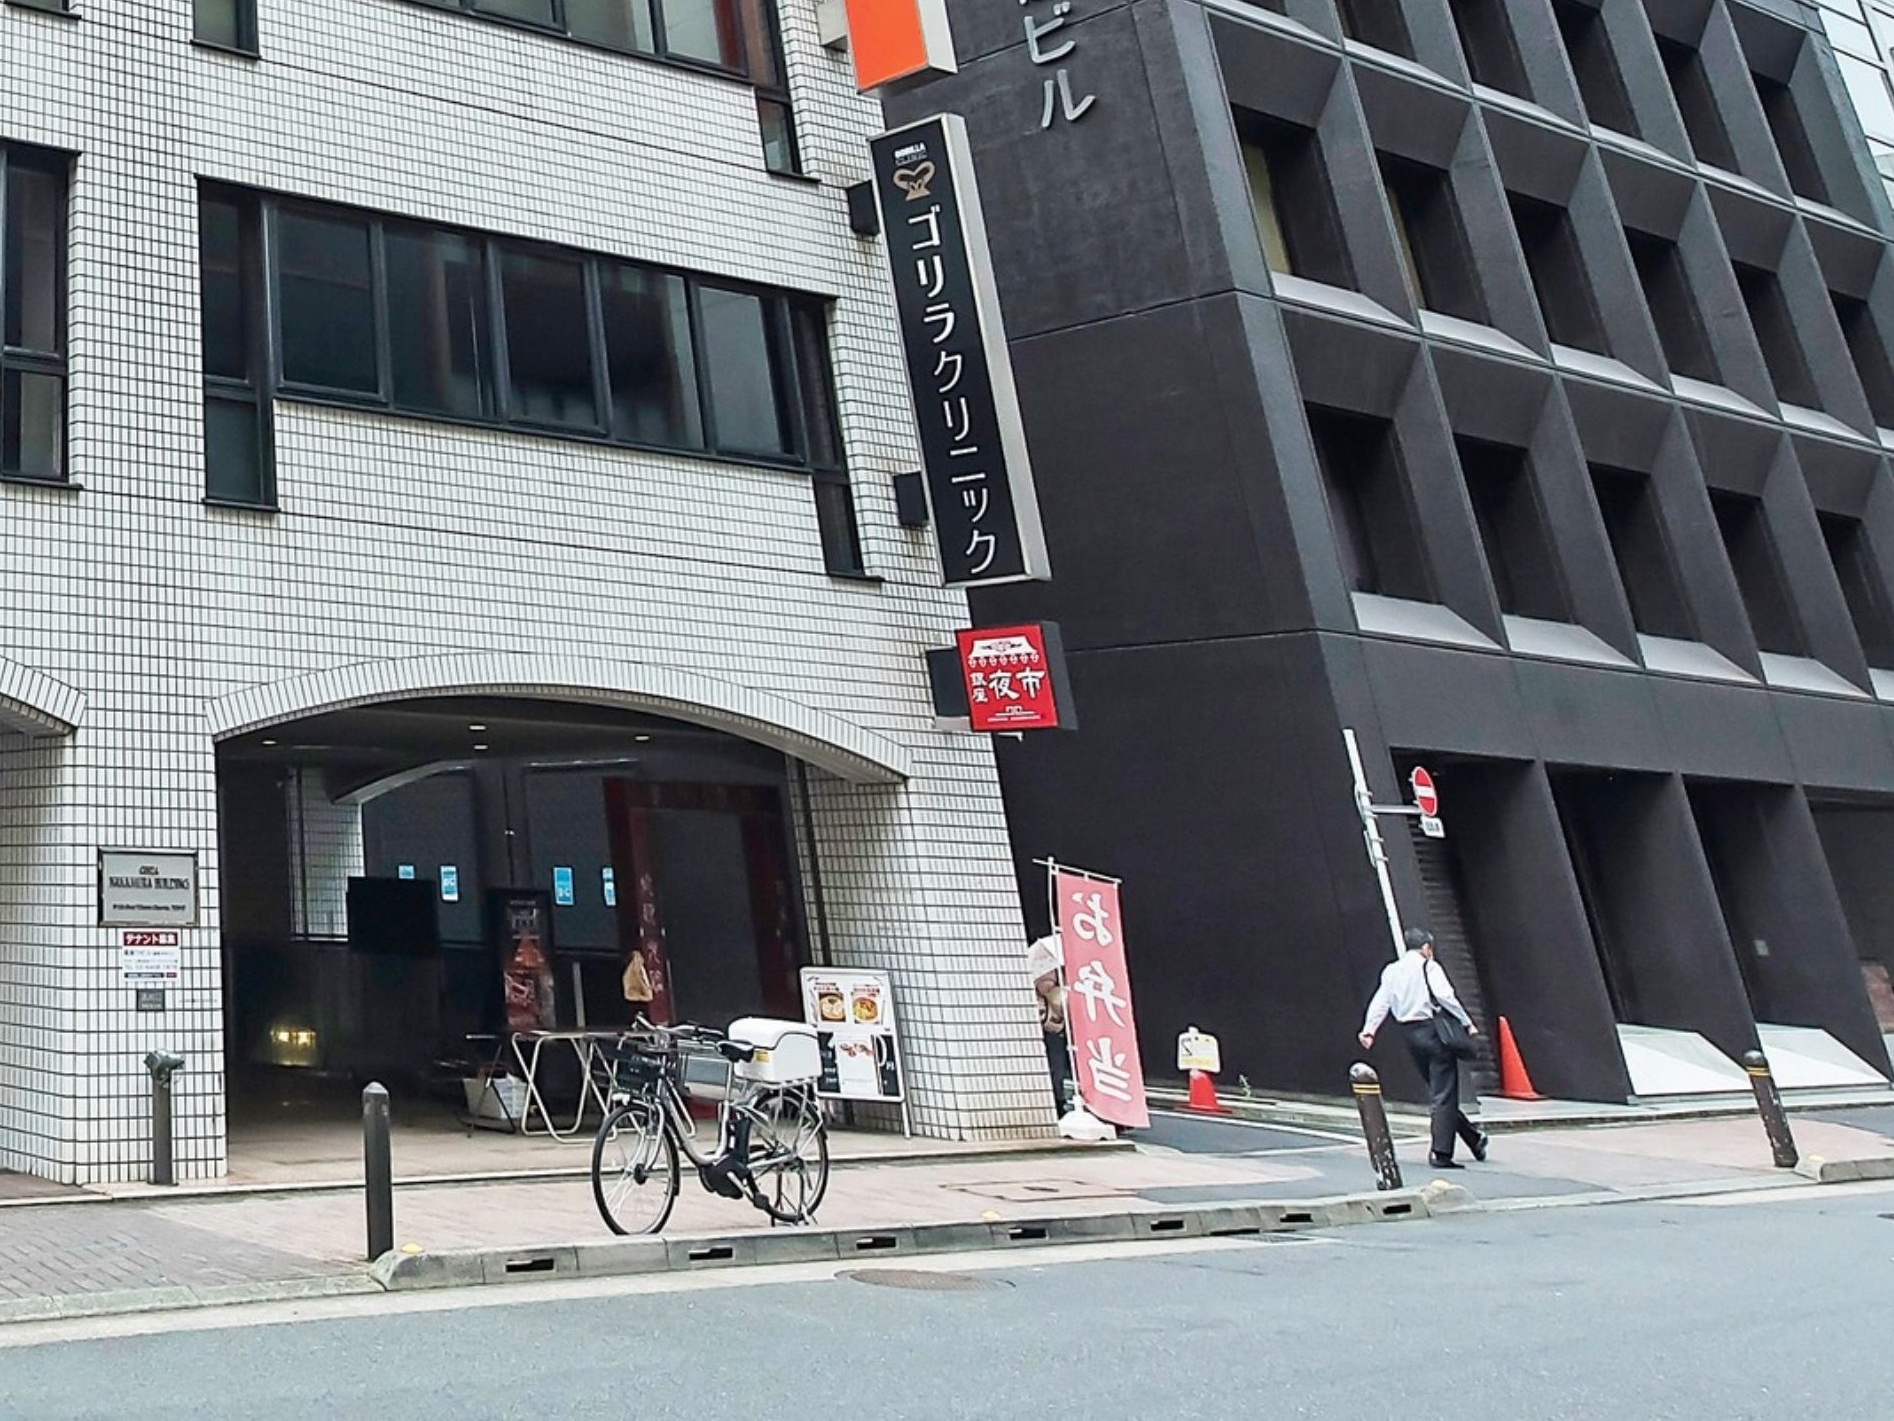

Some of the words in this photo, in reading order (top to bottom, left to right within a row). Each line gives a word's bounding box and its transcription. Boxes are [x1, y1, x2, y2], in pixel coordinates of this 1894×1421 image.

[907, 202, 999, 575] ゴリラクリニック
[988, 667, 1046, 701] 夜市
[1070, 890, 1133, 1103] お弁当
